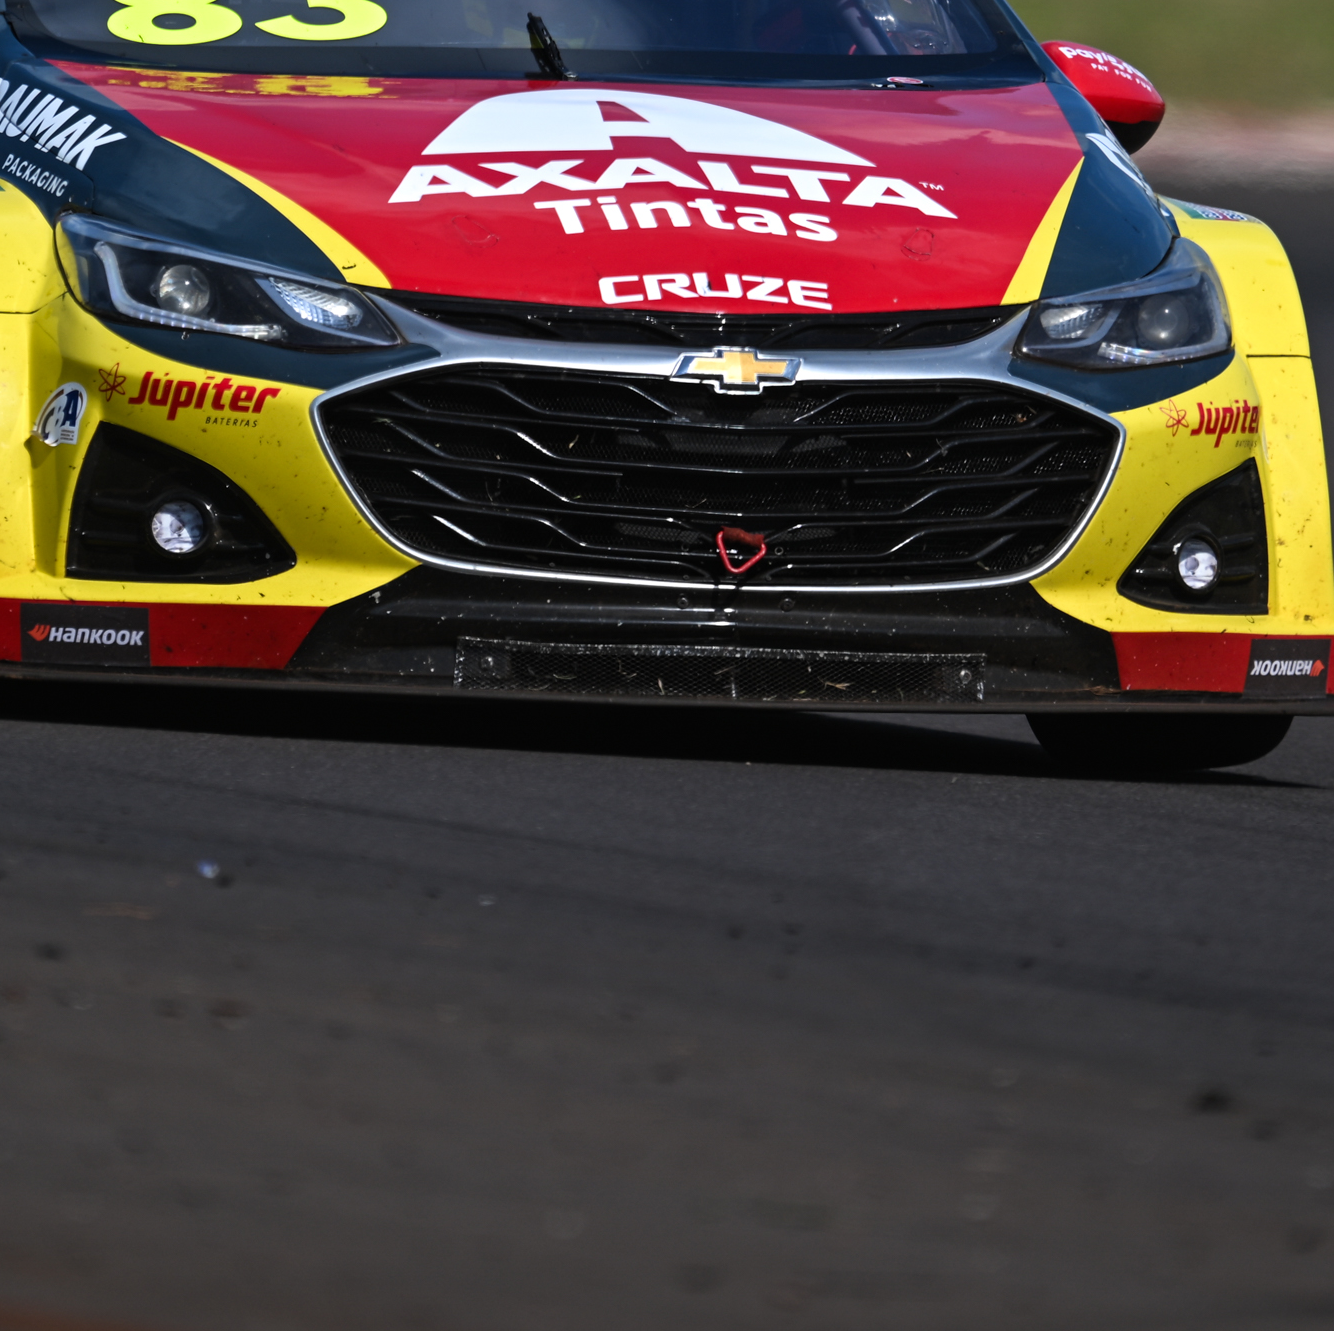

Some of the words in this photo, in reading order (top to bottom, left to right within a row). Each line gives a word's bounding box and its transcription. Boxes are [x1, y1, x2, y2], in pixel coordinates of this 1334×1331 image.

[2, 154, 69, 197] PACKAGING
[388, 158, 958, 219] AXALTA
[533, 195, 838, 242] Tintas
[598, 271, 833, 310] CRUZE
[205, 416, 258, 428] BATERIAS
